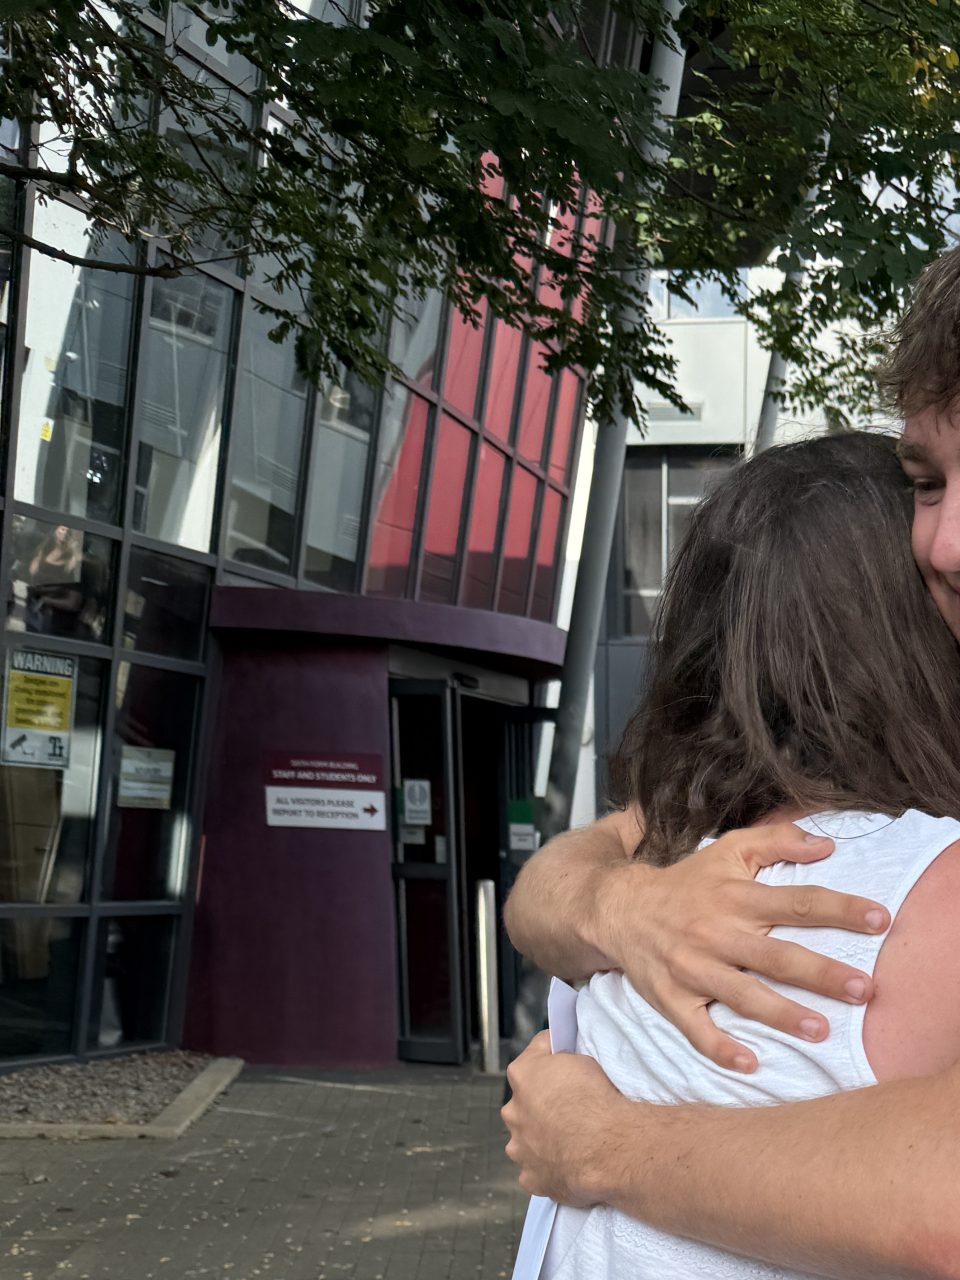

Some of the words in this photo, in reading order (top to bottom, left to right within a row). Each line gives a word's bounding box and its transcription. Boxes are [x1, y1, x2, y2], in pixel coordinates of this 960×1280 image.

[13, 651, 73, 676] WARNING
[272, 770, 295, 779] STAFF
[297, 771, 314, 780] AND
[315, 772, 356, 782] STUDENTS
[357, 774, 377, 783] ONLY
[276, 797, 290, 805] ALL
[291, 798, 326, 806] VISITORS
[327, 799, 355, 808] PLEASE
[272, 808, 302, 817] REPORT
[304, 809, 315, 817] TO
[316, 810, 359, 819] RECEPTION
